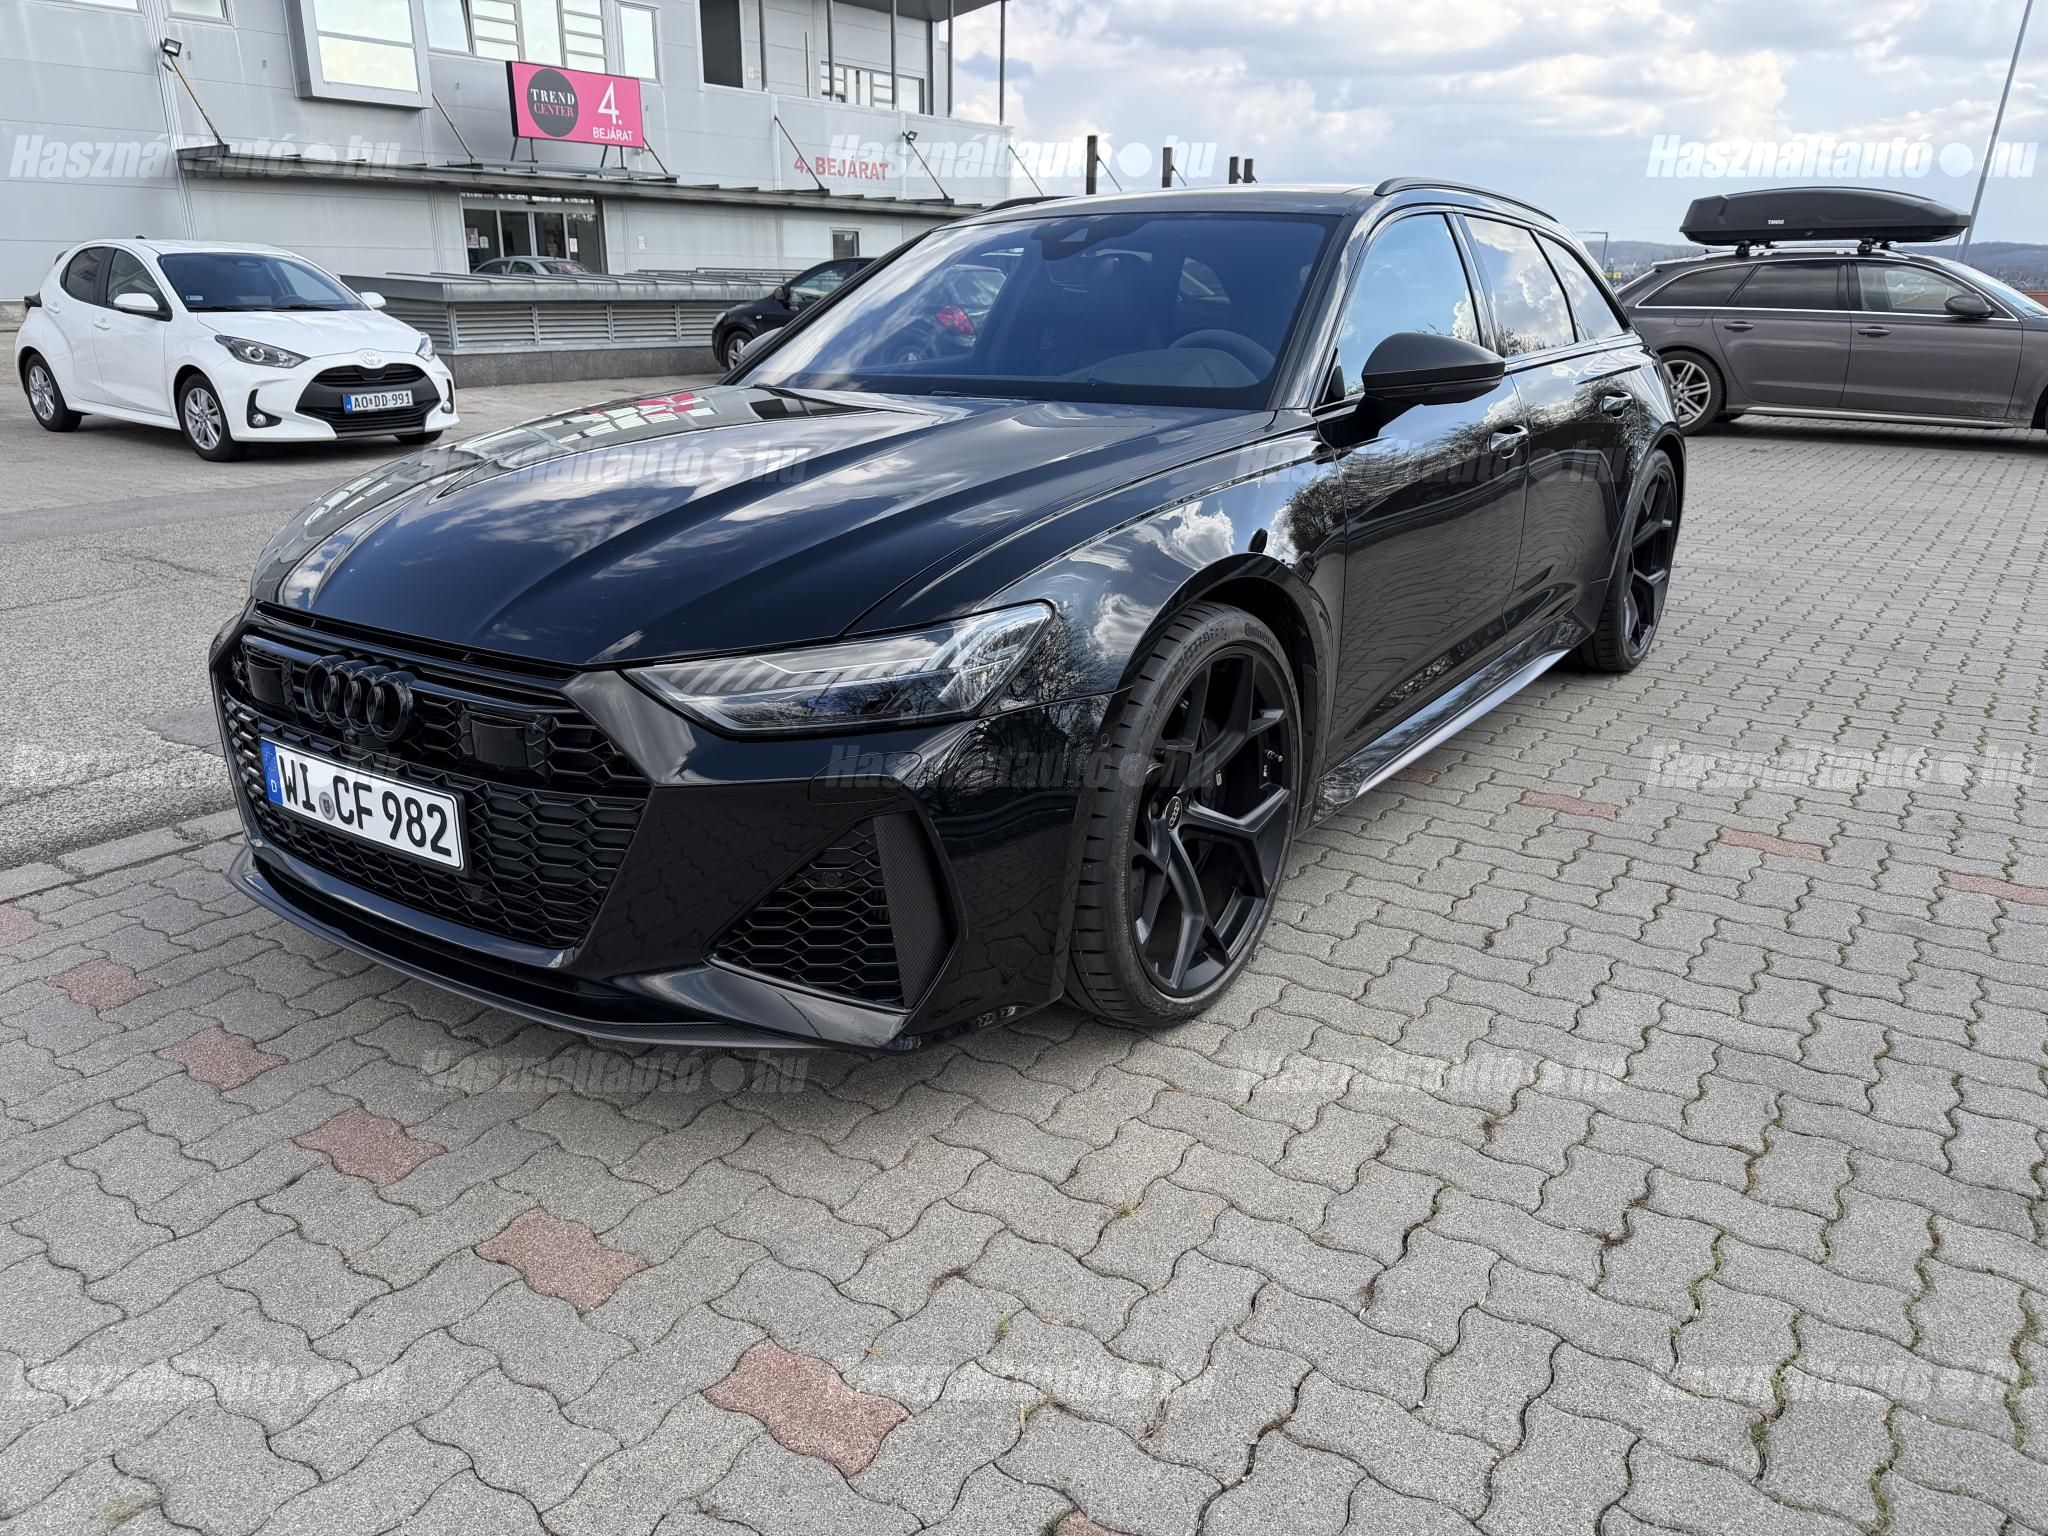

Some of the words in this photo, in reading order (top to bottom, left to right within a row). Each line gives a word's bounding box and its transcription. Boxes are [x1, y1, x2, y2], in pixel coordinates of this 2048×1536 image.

[530, 88, 575, 105] TREND
[597, 80, 623, 125] 4.
[533, 102, 574, 118] CENTER
[592, 124, 633, 142] BEJÁRAT
[815, 154, 889, 181] BEJÁRAT
[278, 754, 317, 813] WI
[332, 774, 373, 830] CF
[381, 789, 452, 858] 982
